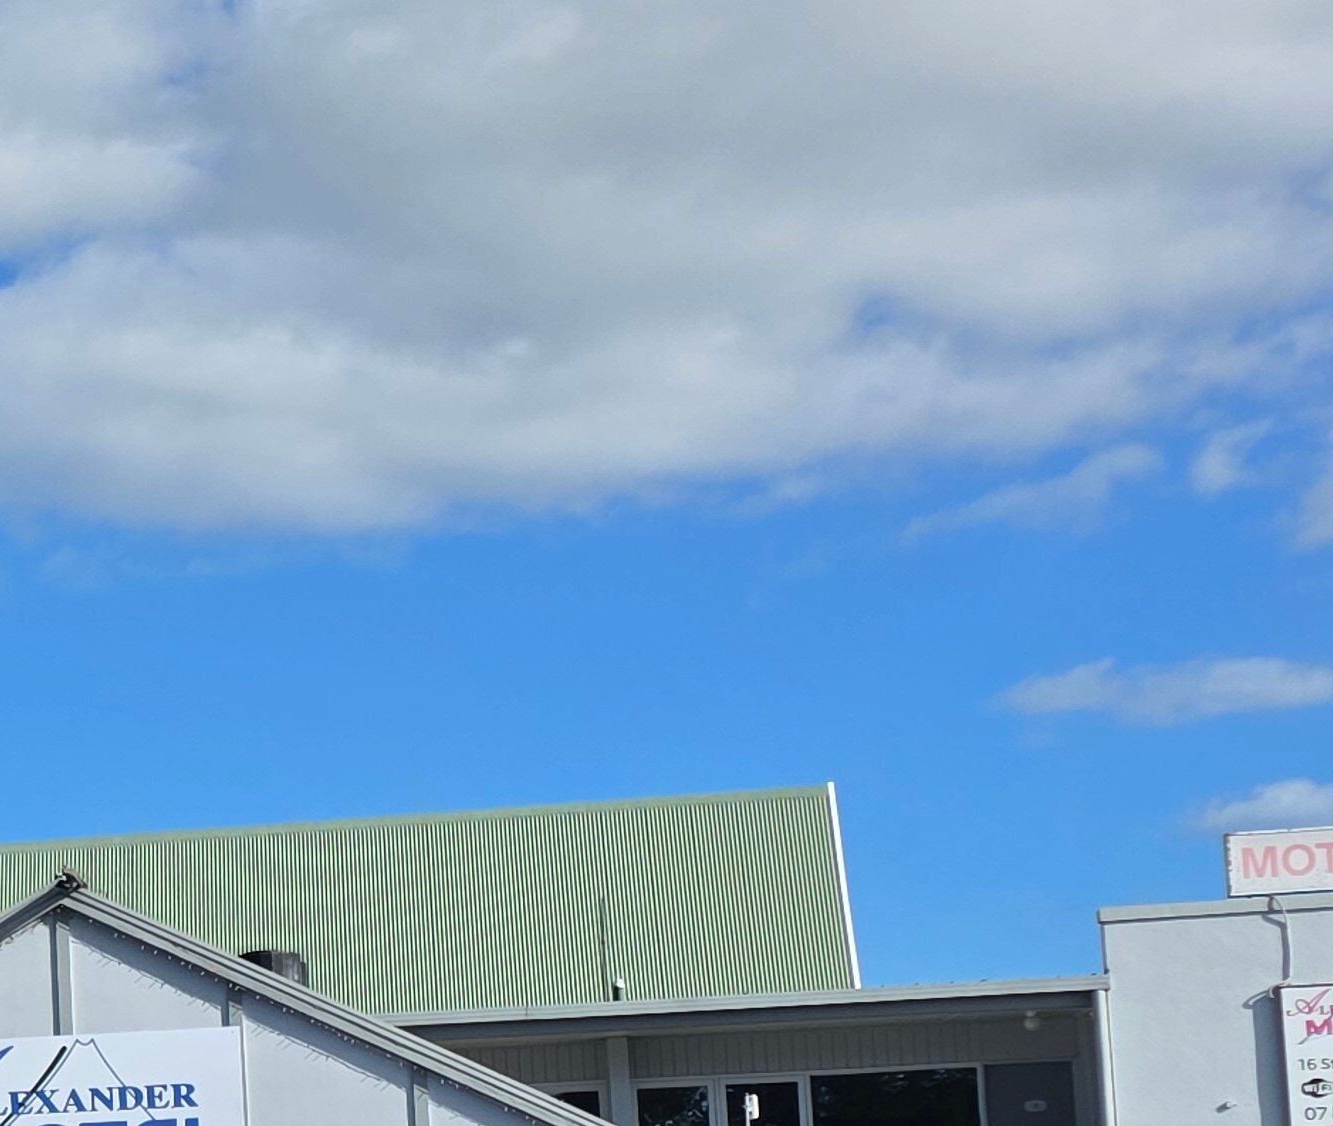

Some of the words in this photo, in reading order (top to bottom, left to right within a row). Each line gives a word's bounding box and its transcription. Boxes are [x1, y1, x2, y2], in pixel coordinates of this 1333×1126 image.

[1286, 988, 1333, 1017] AL
[1297, 1058, 1318, 1071] 16
[1304, 1106, 1328, 1121] 07
